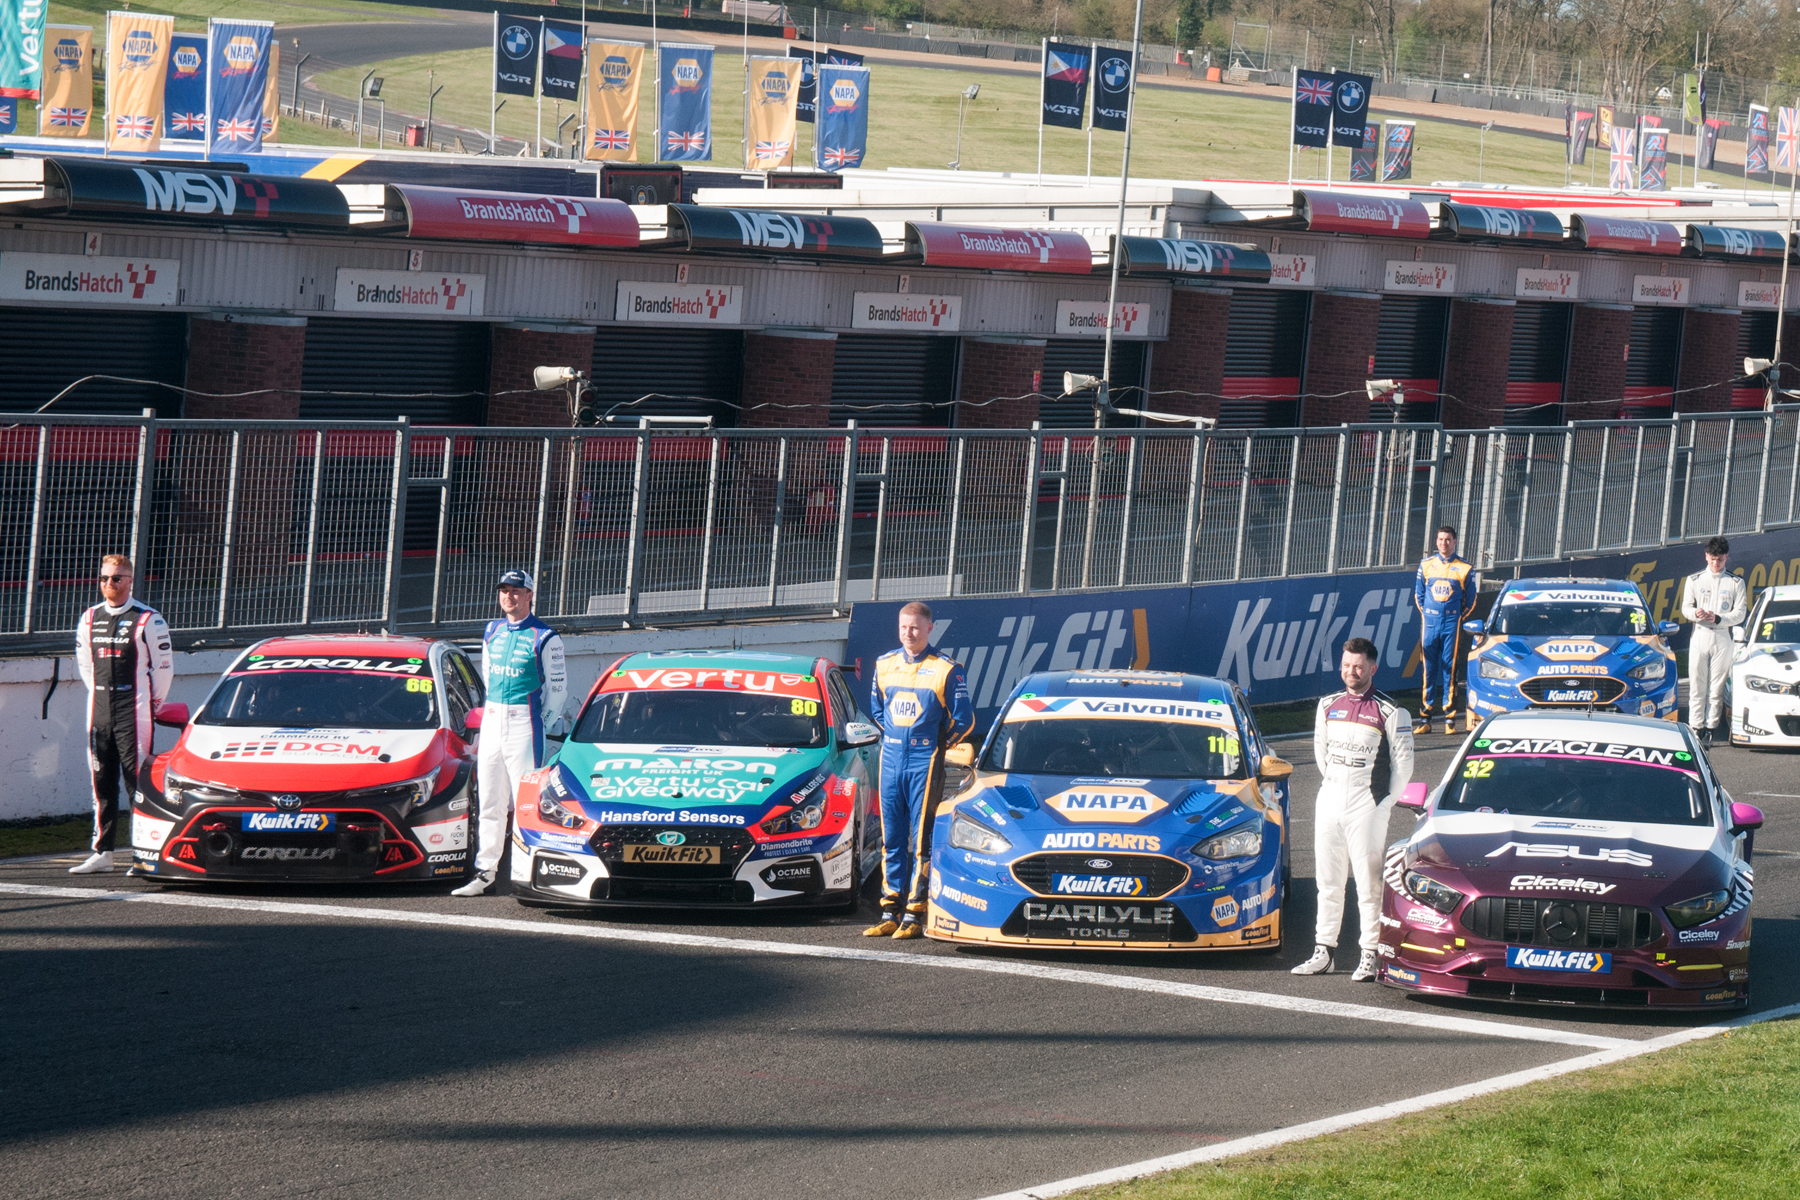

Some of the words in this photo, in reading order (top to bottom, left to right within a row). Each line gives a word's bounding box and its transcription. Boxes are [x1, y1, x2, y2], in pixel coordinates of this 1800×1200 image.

[127, 40, 152, 54] NAPA
[230, 45, 255, 61] NAPA
[177, 53, 198, 66] NAPA
[604, 63, 626, 77] NAPA
[676, 66, 699, 81] NAPA
[766, 78, 787, 92] NAPA
[834, 86, 855, 100] NAPA
[1044, 103, 1080, 116] WSR
[132, 168, 237, 216] MSV
[729, 210, 805, 249] MSV
[1478, 207, 1521, 237] MSV
[89, 235, 98, 250] 4
[1718, 229, 1753, 255] MSV
[412, 252, 420, 267] 5
[1159, 239, 1213, 273] MSV
[679, 265, 686, 280] 6
[1395, 271, 1434, 286] BrandsHatch
[25, 269, 123, 293] BrandsHatch
[356, 283, 439, 305] BrandsHatch
[634, 295, 703, 315] BrandsHatch
[868, 305, 928, 323] BrandsHatch
[1434, 585, 1450, 596] NAPA
[1547, 593, 1634, 603] Valvoline
[1761, 622, 1774, 636] 2
[1548, 644, 1597, 654] NAPA
[247, 657, 422, 674] COROLLA
[1537, 665, 1570, 675] AUTO
[1570, 665, 1609, 675] PARTS
[406, 678, 433, 693] 66
[628, 669, 775, 691] Vertu
[791, 699, 817, 717] 80
[894, 702, 917, 717] NAPA
[1082, 701, 1223, 721] Valvoline
[283, 741, 381, 756] DCM
[1207, 735, 1239, 756] 116
[1463, 760, 1495, 778] 32
[615, 776, 700, 787] Vertu
[717, 778, 772, 793] Car
[798, 779, 820, 797] MILLERS
[1066, 794, 1148, 811] NAPA
[601, 811, 675, 823] Hansford
[679, 811, 746, 825] Sensors
[760, 838, 814, 851] Diamondbrite
[1042, 833, 1095, 849] AUTO
[1097, 833, 1161, 851] PARTS
[241, 847, 336, 861] COROLLA
[427, 851, 466, 863] COROLLA
[1485, 841, 1653, 867] ASUS
[548, 863, 581, 875] OCTANE
[777, 867, 811, 877] OCTANE
[1510, 875, 1617, 895] Ciceley
[942, 885, 960, 903] AUTO
[960, 892, 988, 912] PARTS
[1241, 894, 1261, 911] AUTO
[1023, 903, 1175, 924] CARLYLE
[1215, 902, 1236, 920] NAPA
[1407, 908, 1448, 926] Ciceley
[1067, 927, 1130, 939] TOOLS
[1678, 929, 1720, 941] Ciceley
